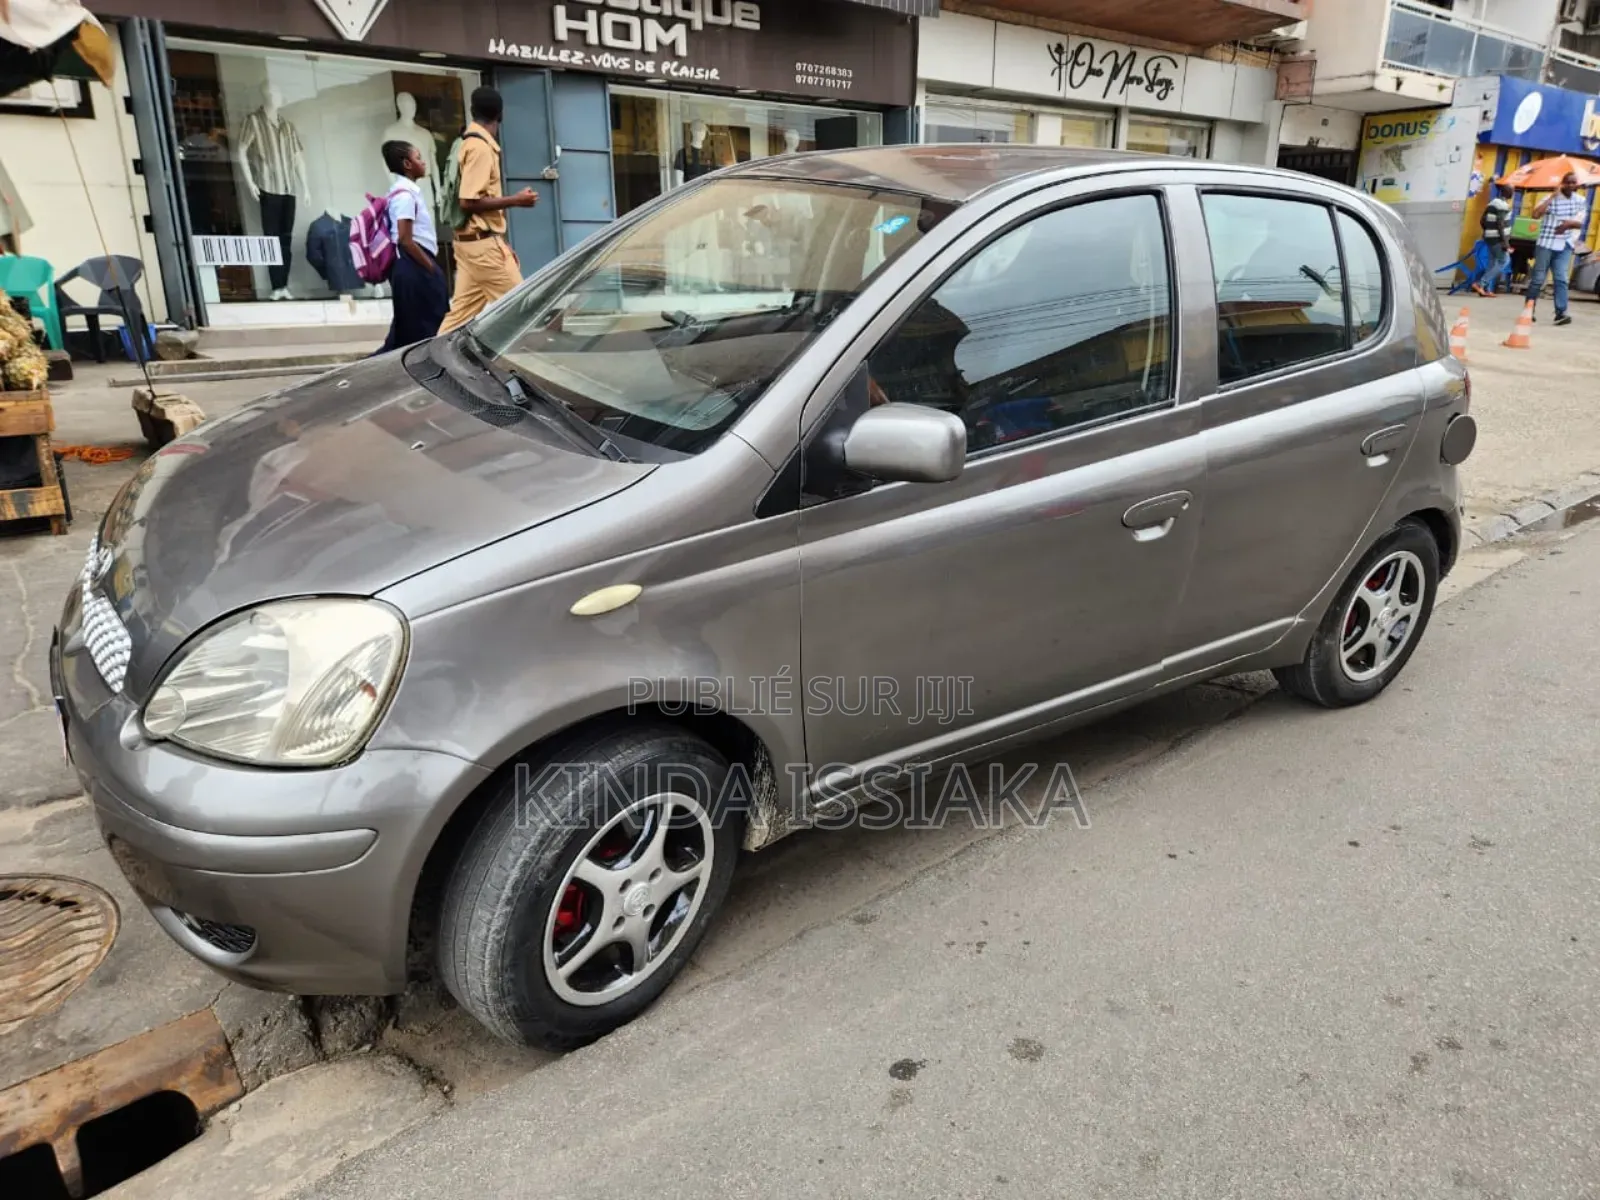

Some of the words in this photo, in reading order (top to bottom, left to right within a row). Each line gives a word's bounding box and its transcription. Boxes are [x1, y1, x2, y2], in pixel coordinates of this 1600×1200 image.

[554, 4, 687, 57] HOM
[634, 60, 655, 74] DE
[660, 61, 720, 80] PLAISIR
[1365, 119, 1430, 140] bonus
